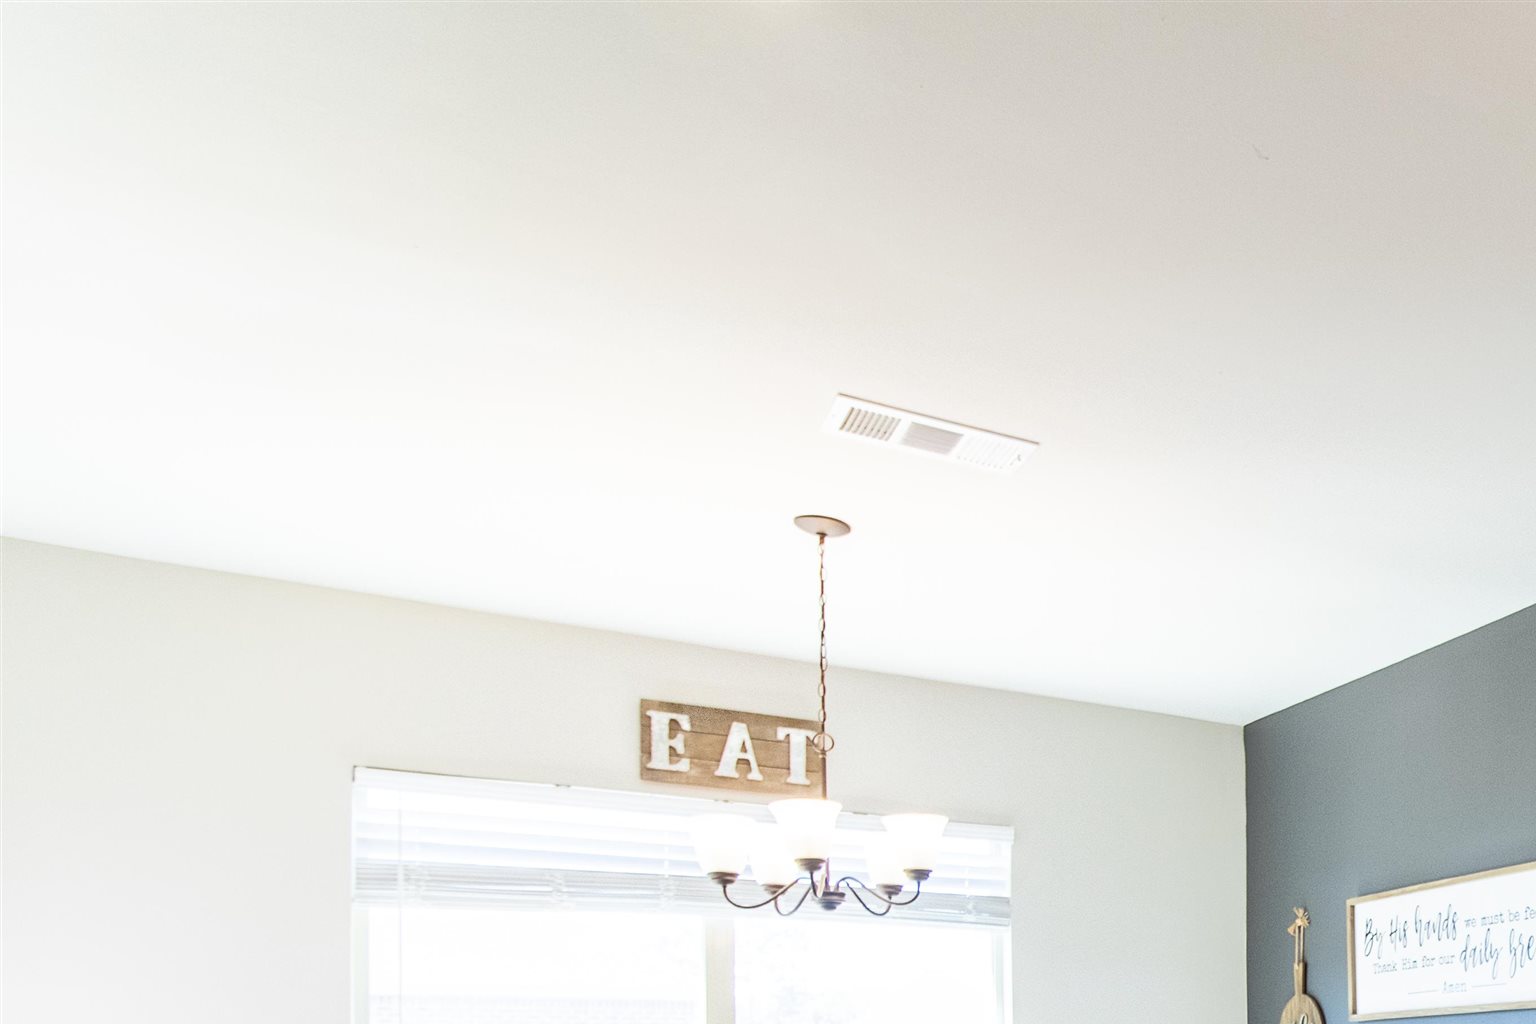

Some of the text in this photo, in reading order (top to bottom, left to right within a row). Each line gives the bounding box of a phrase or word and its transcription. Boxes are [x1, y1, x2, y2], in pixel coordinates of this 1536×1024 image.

[646, 709, 817, 786] EAT
[1364, 917, 1384, 959] By
[1389, 914, 1408, 952] His
[1414, 903, 1458, 947] hands
[1481, 911, 1505, 927] must
[1507, 908, 1520, 922] be
[1421, 955, 1436, 968] for
[1459, 927, 1504, 980] daily
